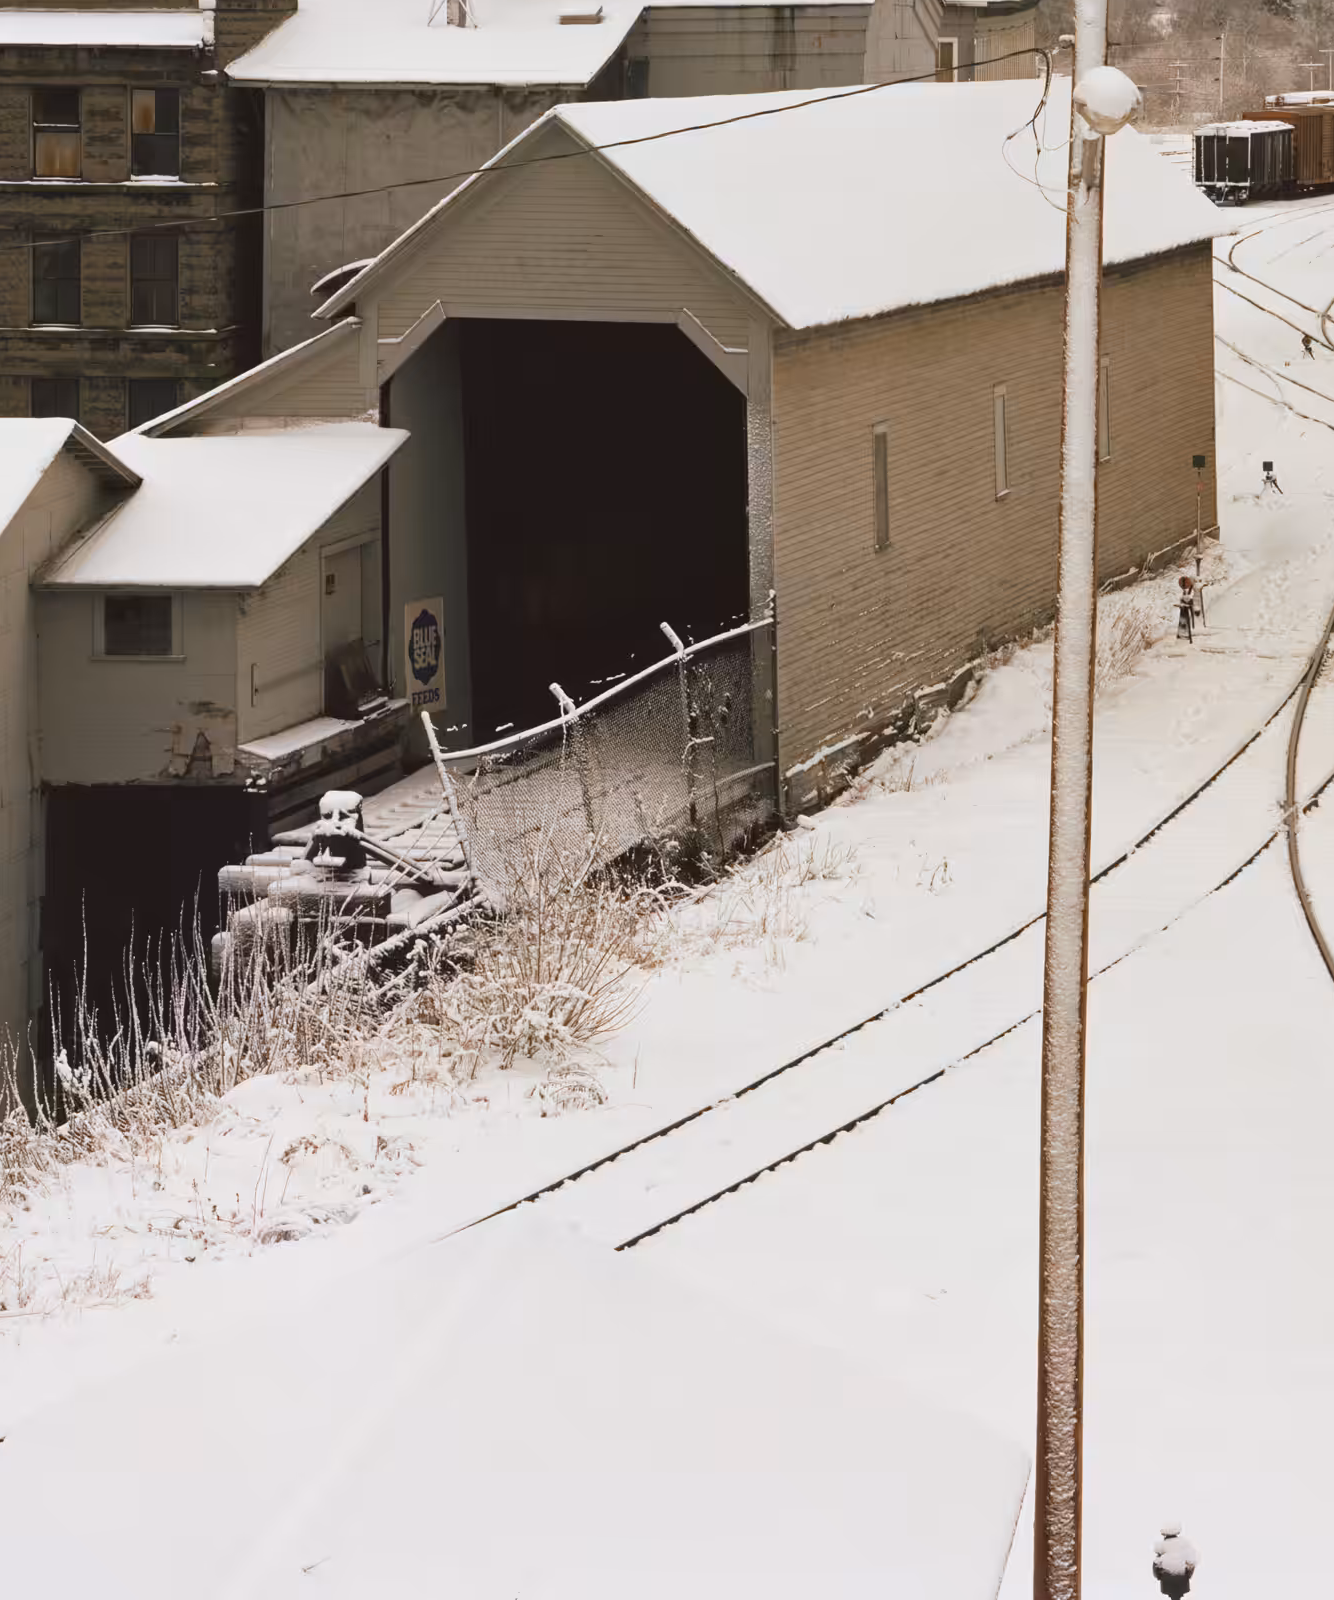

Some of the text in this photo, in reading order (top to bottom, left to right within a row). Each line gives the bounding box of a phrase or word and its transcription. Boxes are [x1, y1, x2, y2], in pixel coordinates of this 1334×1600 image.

[413, 626, 438, 649] BLUE
[413, 647, 438, 670] SEAL
[411, 688, 441, 705] FEEDS
